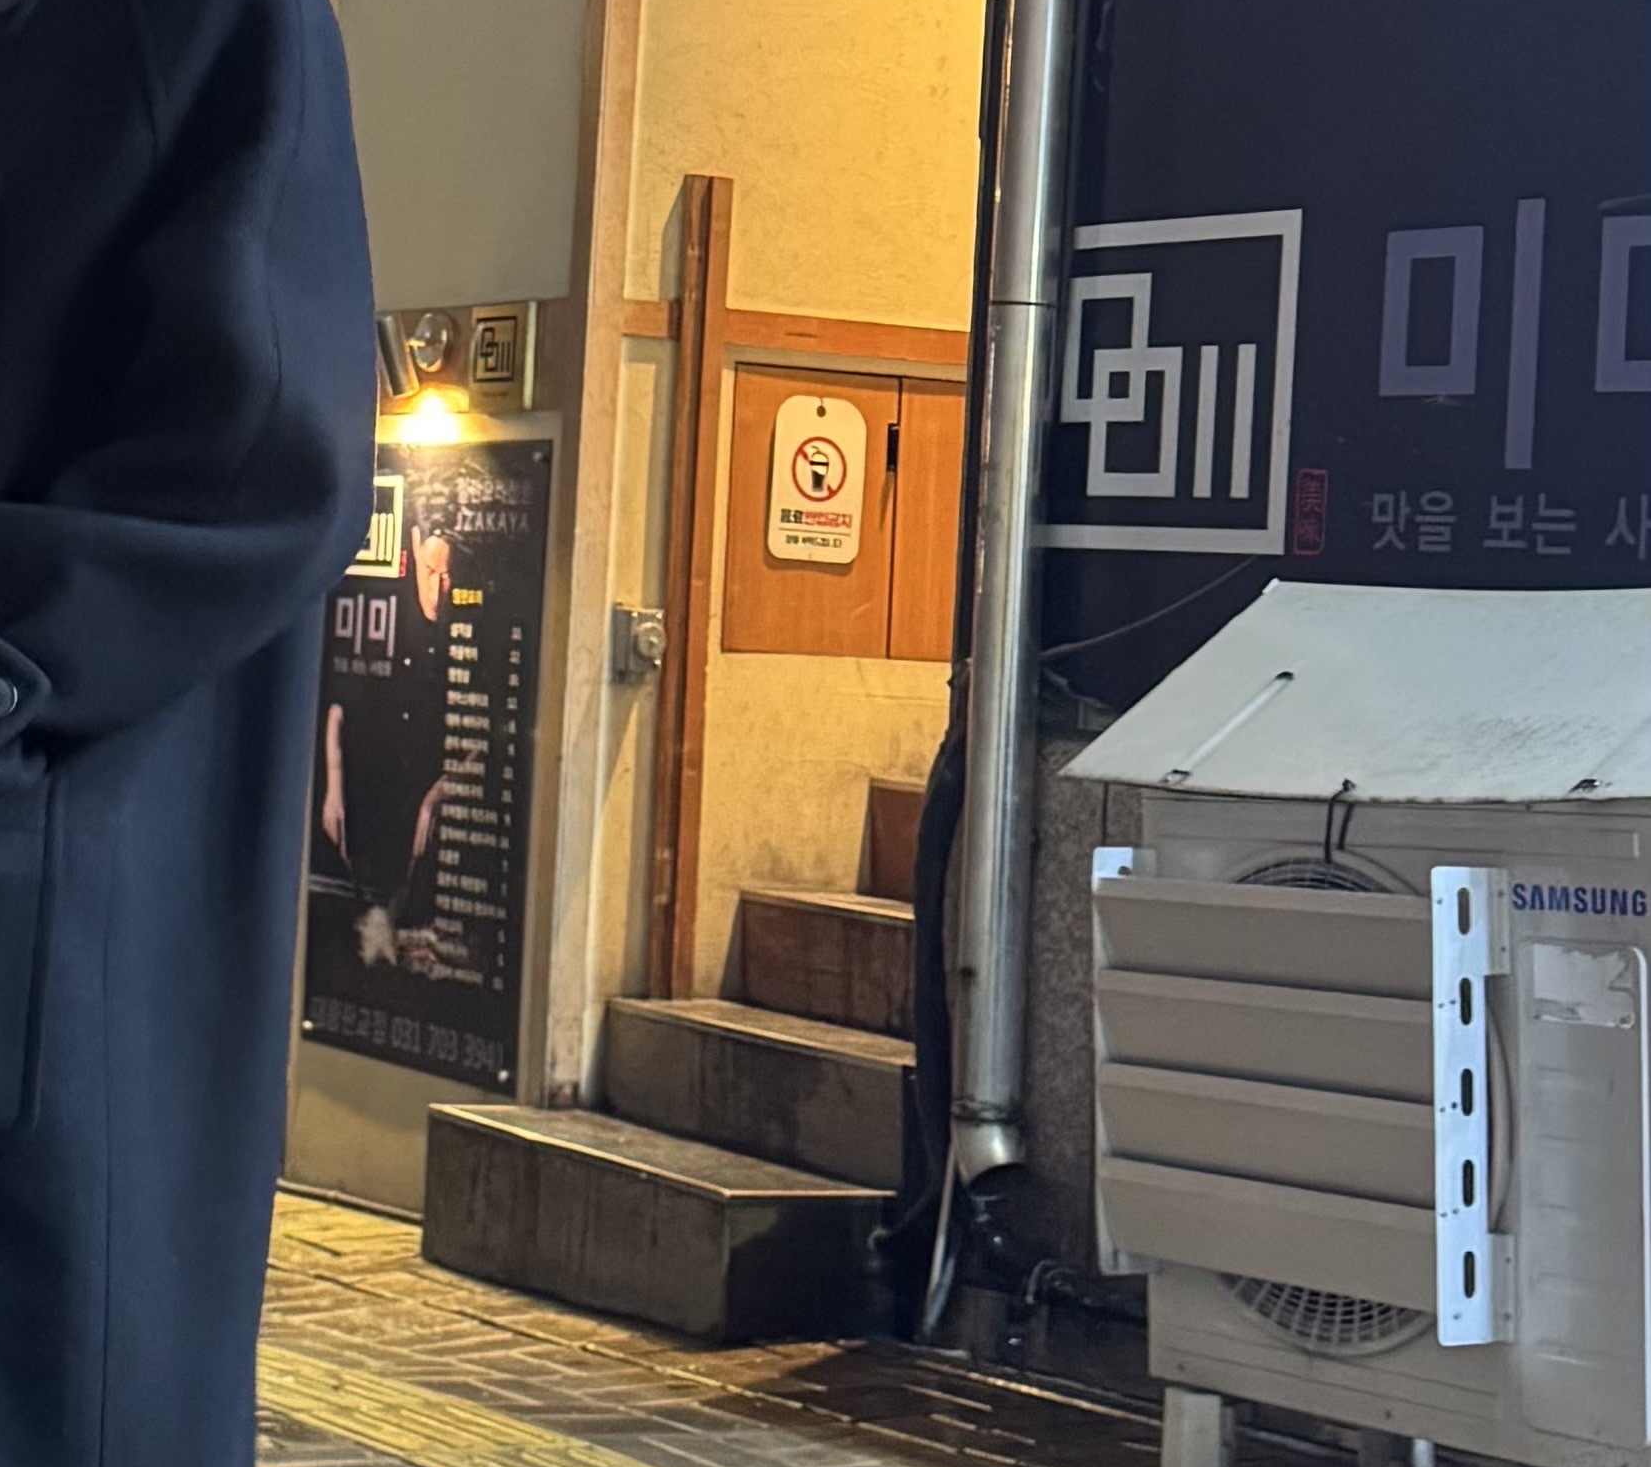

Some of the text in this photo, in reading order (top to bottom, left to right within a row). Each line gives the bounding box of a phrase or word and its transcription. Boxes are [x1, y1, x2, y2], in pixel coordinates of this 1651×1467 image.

[1371, 490, 1458, 552] 맛을
[1482, 492, 1578, 555] 보는
[334, 592, 397, 659] 미미
[1512, 883, 1648, 917] SAMSUNG
